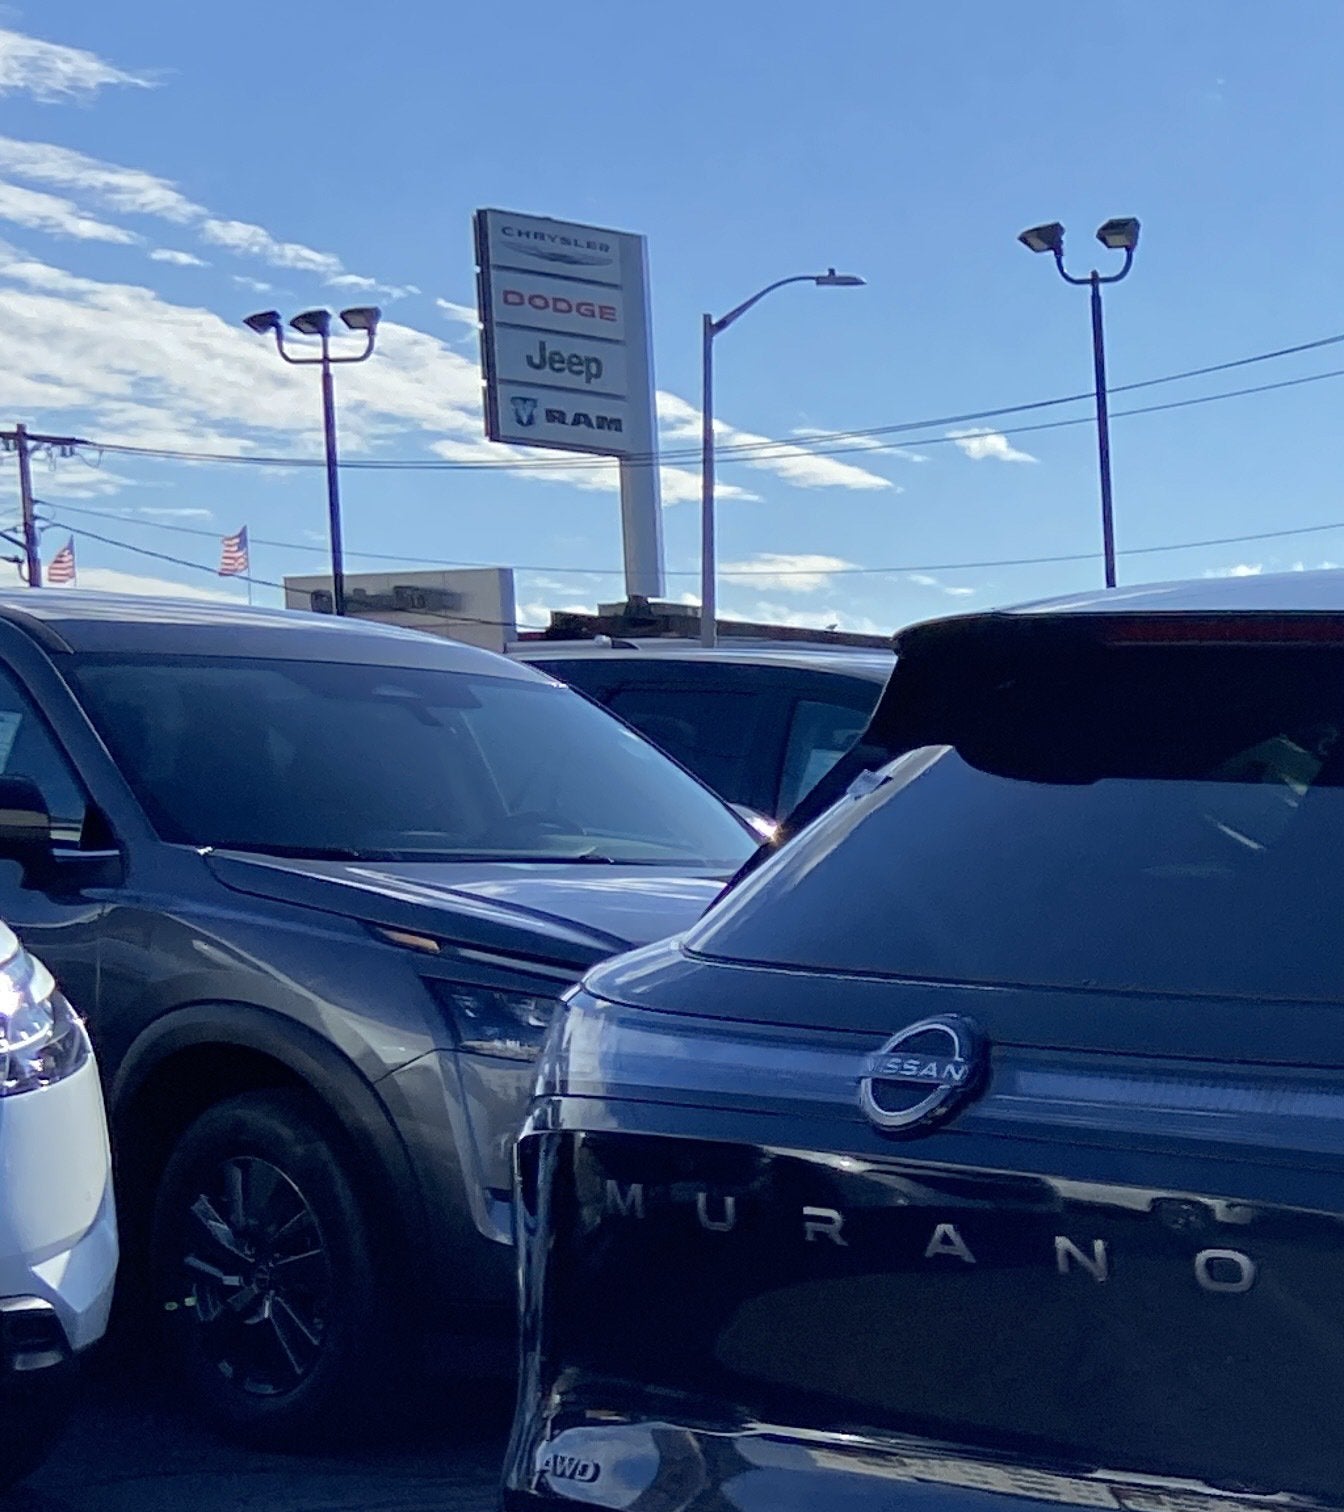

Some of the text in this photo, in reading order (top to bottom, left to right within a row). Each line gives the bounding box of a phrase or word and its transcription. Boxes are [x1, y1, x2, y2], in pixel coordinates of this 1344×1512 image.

[501, 226, 610, 253] CHRYSLER
[502, 289, 617, 322] DODGE
[526, 340, 603, 384] Jeep
[545, 407, 623, 433] RAM
[604, 1178, 1256, 1295] MURANO
[541, 1454, 601, 1484] AWD
